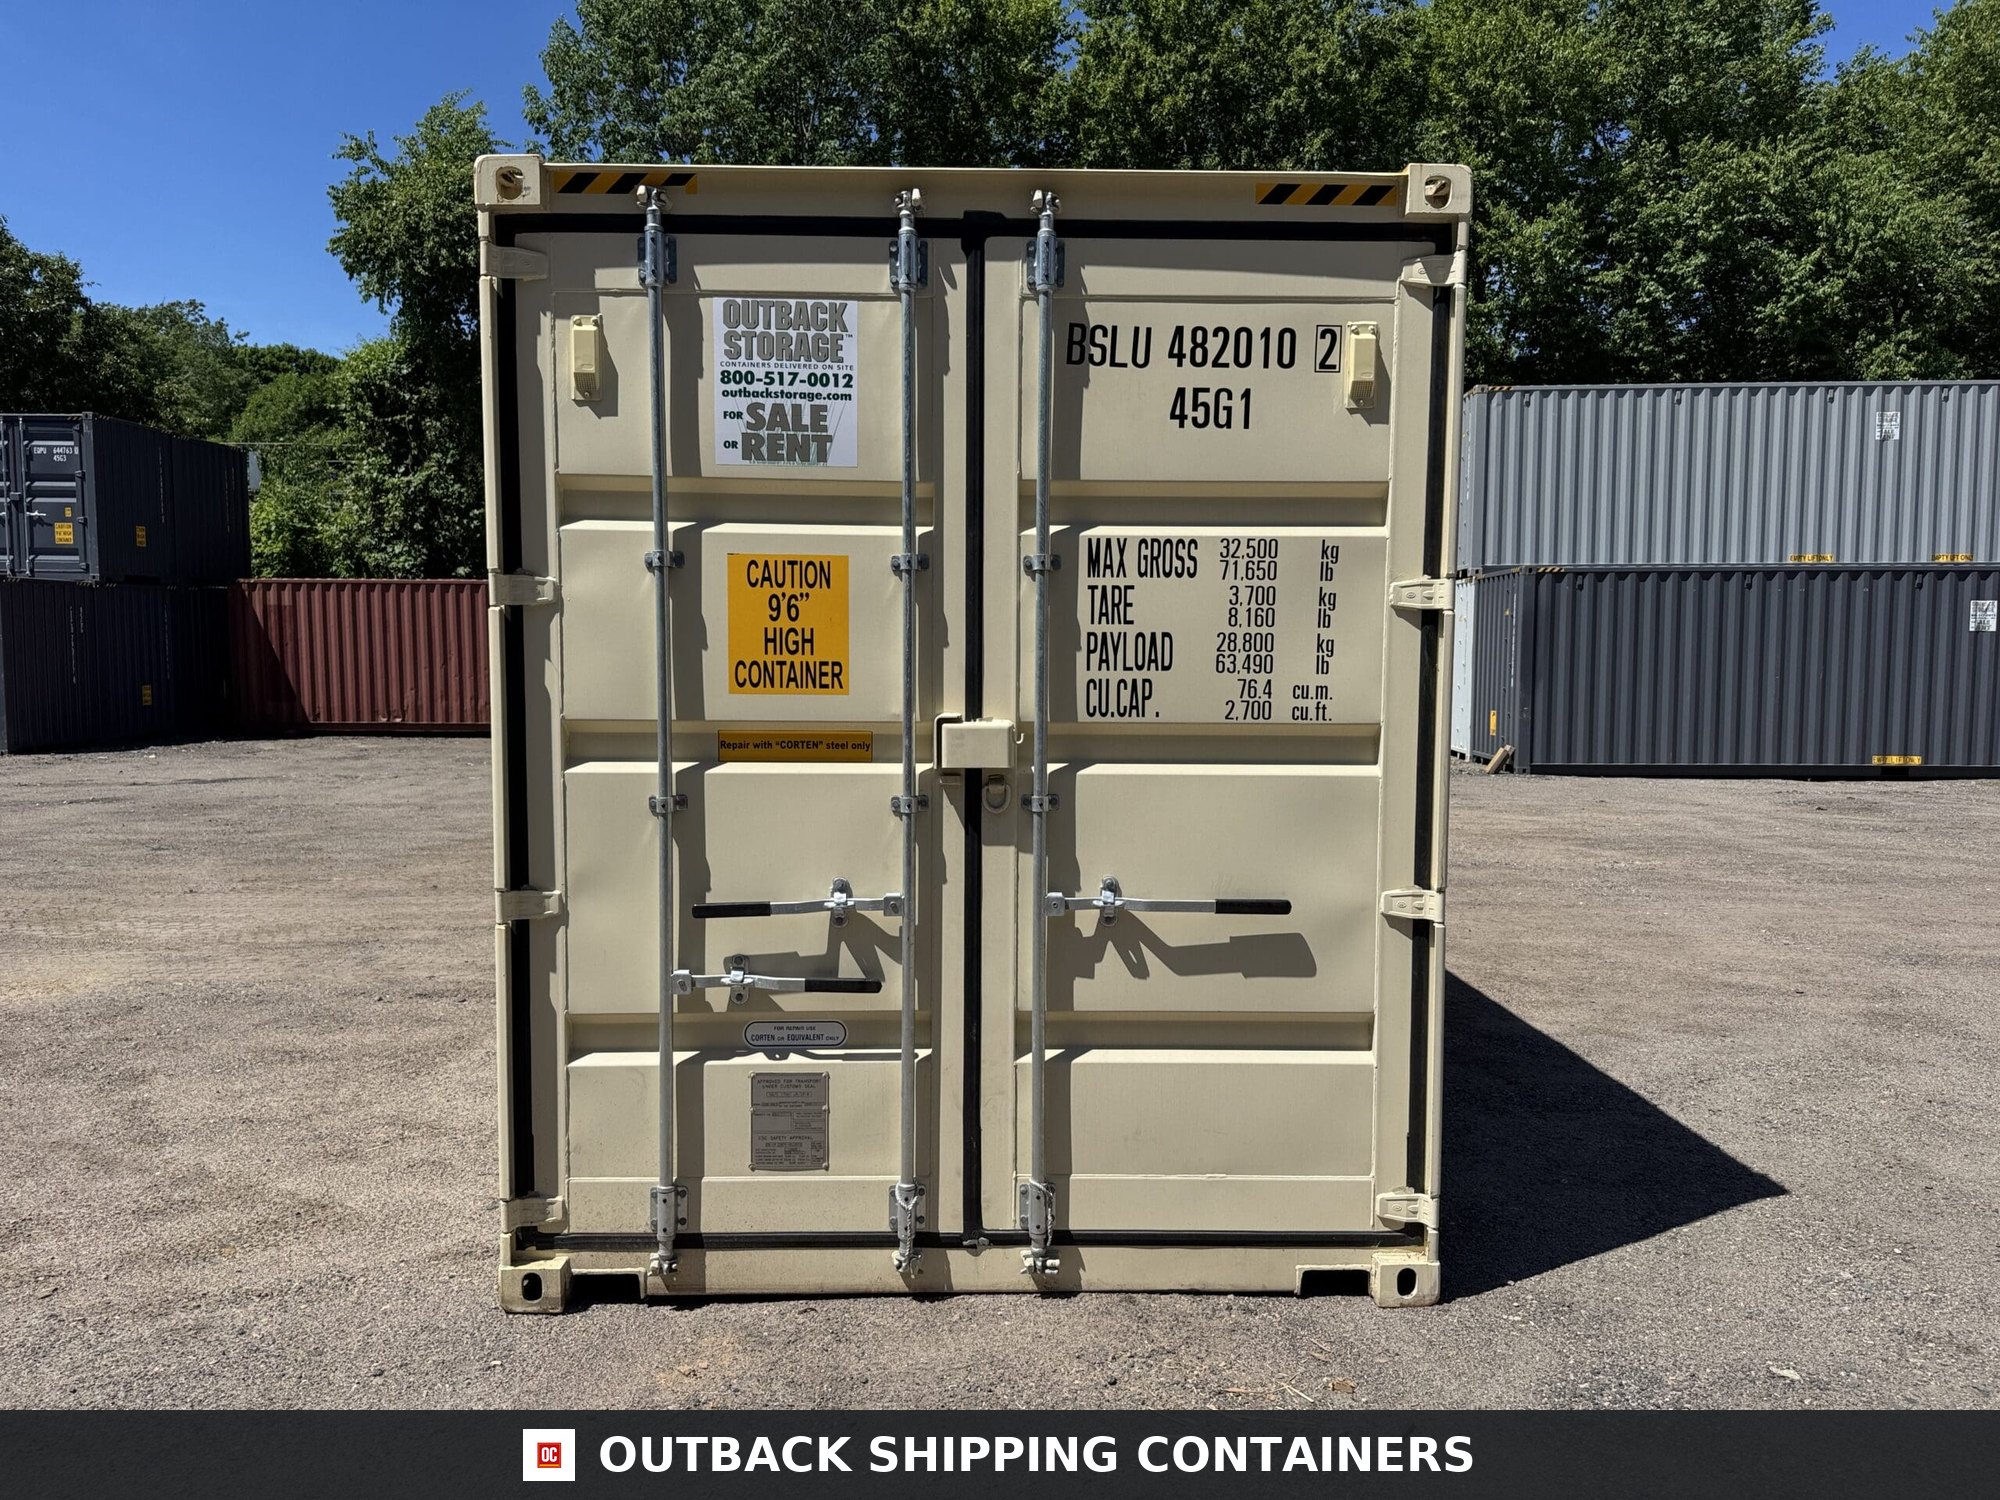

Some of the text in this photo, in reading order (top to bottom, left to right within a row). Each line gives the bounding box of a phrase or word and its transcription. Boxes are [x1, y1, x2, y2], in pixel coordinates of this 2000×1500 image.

[723, 299, 848, 332] OUTBACK
[1066, 322, 1338, 370] BSLU 482010 2
[720, 370, 853, 388] 800-517-0012
[774, 362, 818, 370] DELIVERED
[721, 387, 852, 402] outbackstorage.com
[1169, 387, 1251, 429] 45G1
[723, 402, 828, 433] FOR SALE
[723, 432, 833, 463] OR RENT
[1087, 538, 1127, 578] MAX
[1137, 538, 1198, 578] GROSS
[1321, 539, 1339, 564] kg
[1220, 560, 1333, 582] 71,650 lb
[746, 559, 831, 589] CAUTION
[1088, 585, 1337, 625] TARE 3,700 kg
[1228, 607, 1331, 629] 8,160 lb
[764, 627, 814, 656] HIGH
[1086, 631, 1335, 671] PAYLOAD 28,800 kg
[734, 660, 844, 689] CONTAINER
[1216, 653, 1330, 675] 63,490 lb
[1086, 678, 1333, 718] CU.CAP. 76.4 cu.m.
[1225, 700, 1332, 721] 2,700 cu.ft.
[720, 741, 750, 751] Repair
[753, 741, 772, 749] with
[826, 741, 848, 749] steel
[851, 741, 871, 752] only
